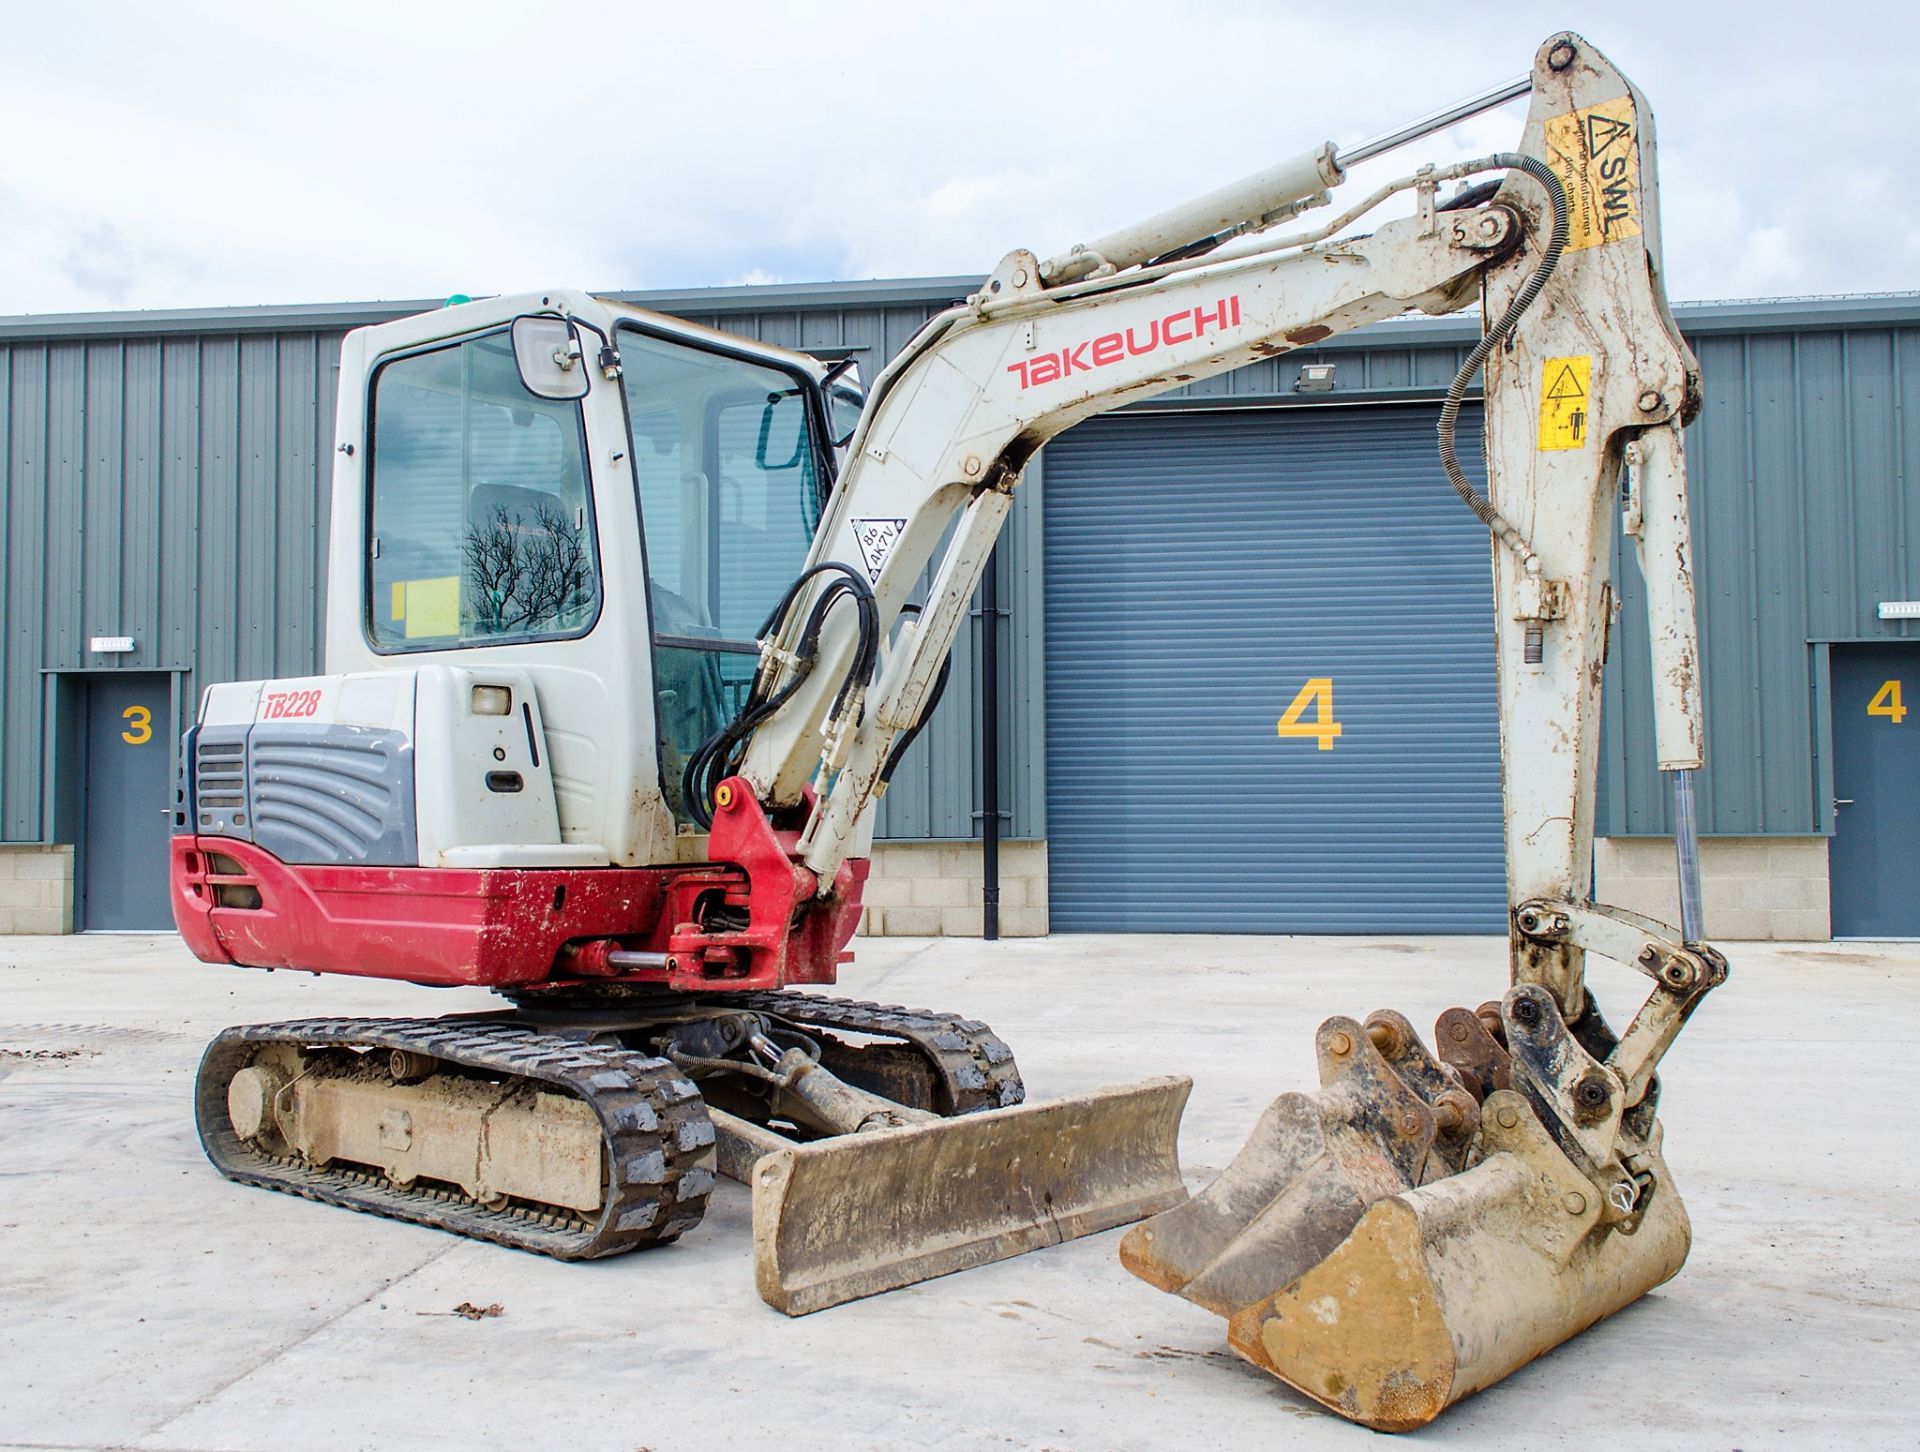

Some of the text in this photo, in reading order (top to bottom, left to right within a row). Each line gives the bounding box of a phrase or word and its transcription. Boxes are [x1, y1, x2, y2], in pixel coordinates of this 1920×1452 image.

[1565, 183, 1576, 213] charts
[1579, 162, 1592, 237] manufacturers
[1600, 157, 1629, 235] SWL
[863, 527, 878, 546] 86
[870, 525, 893, 565] AK7V
[263, 689, 322, 719] TB228
[1277, 677, 1343, 751] 4
[1866, 680, 1908, 724] 4
[121, 705, 153, 745] 3
